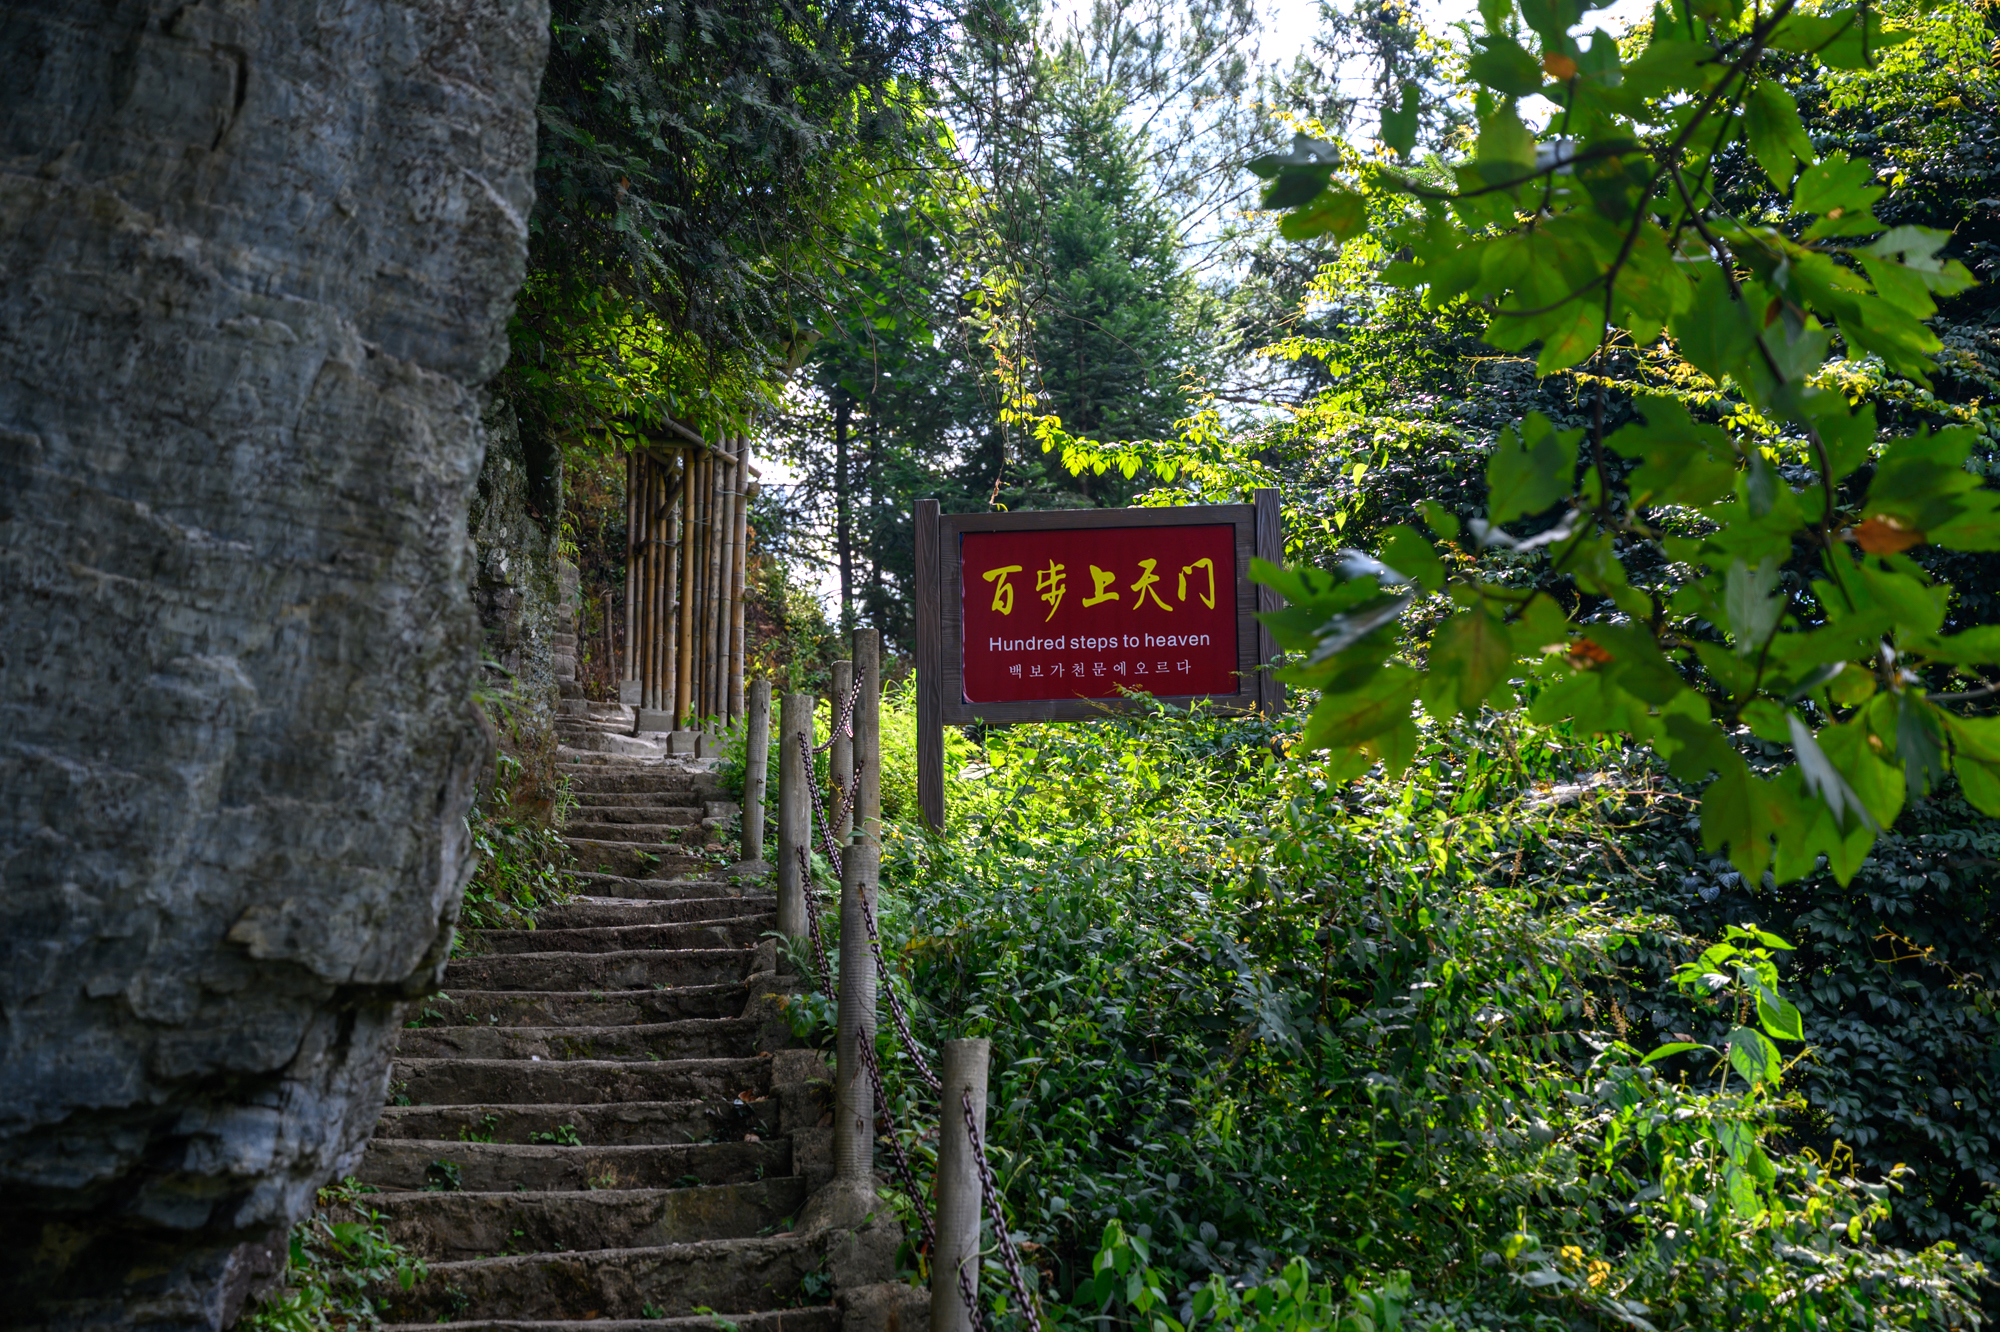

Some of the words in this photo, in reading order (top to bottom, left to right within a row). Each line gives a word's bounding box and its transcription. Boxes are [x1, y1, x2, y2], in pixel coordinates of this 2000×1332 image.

[982, 557, 1216, 623] 百步上天门
[989, 635, 1065, 652] Hundred
[1070, 636, 1118, 652] steps
[1123, 634, 1140, 648] to
[1145, 632, 1210, 648] heaven
